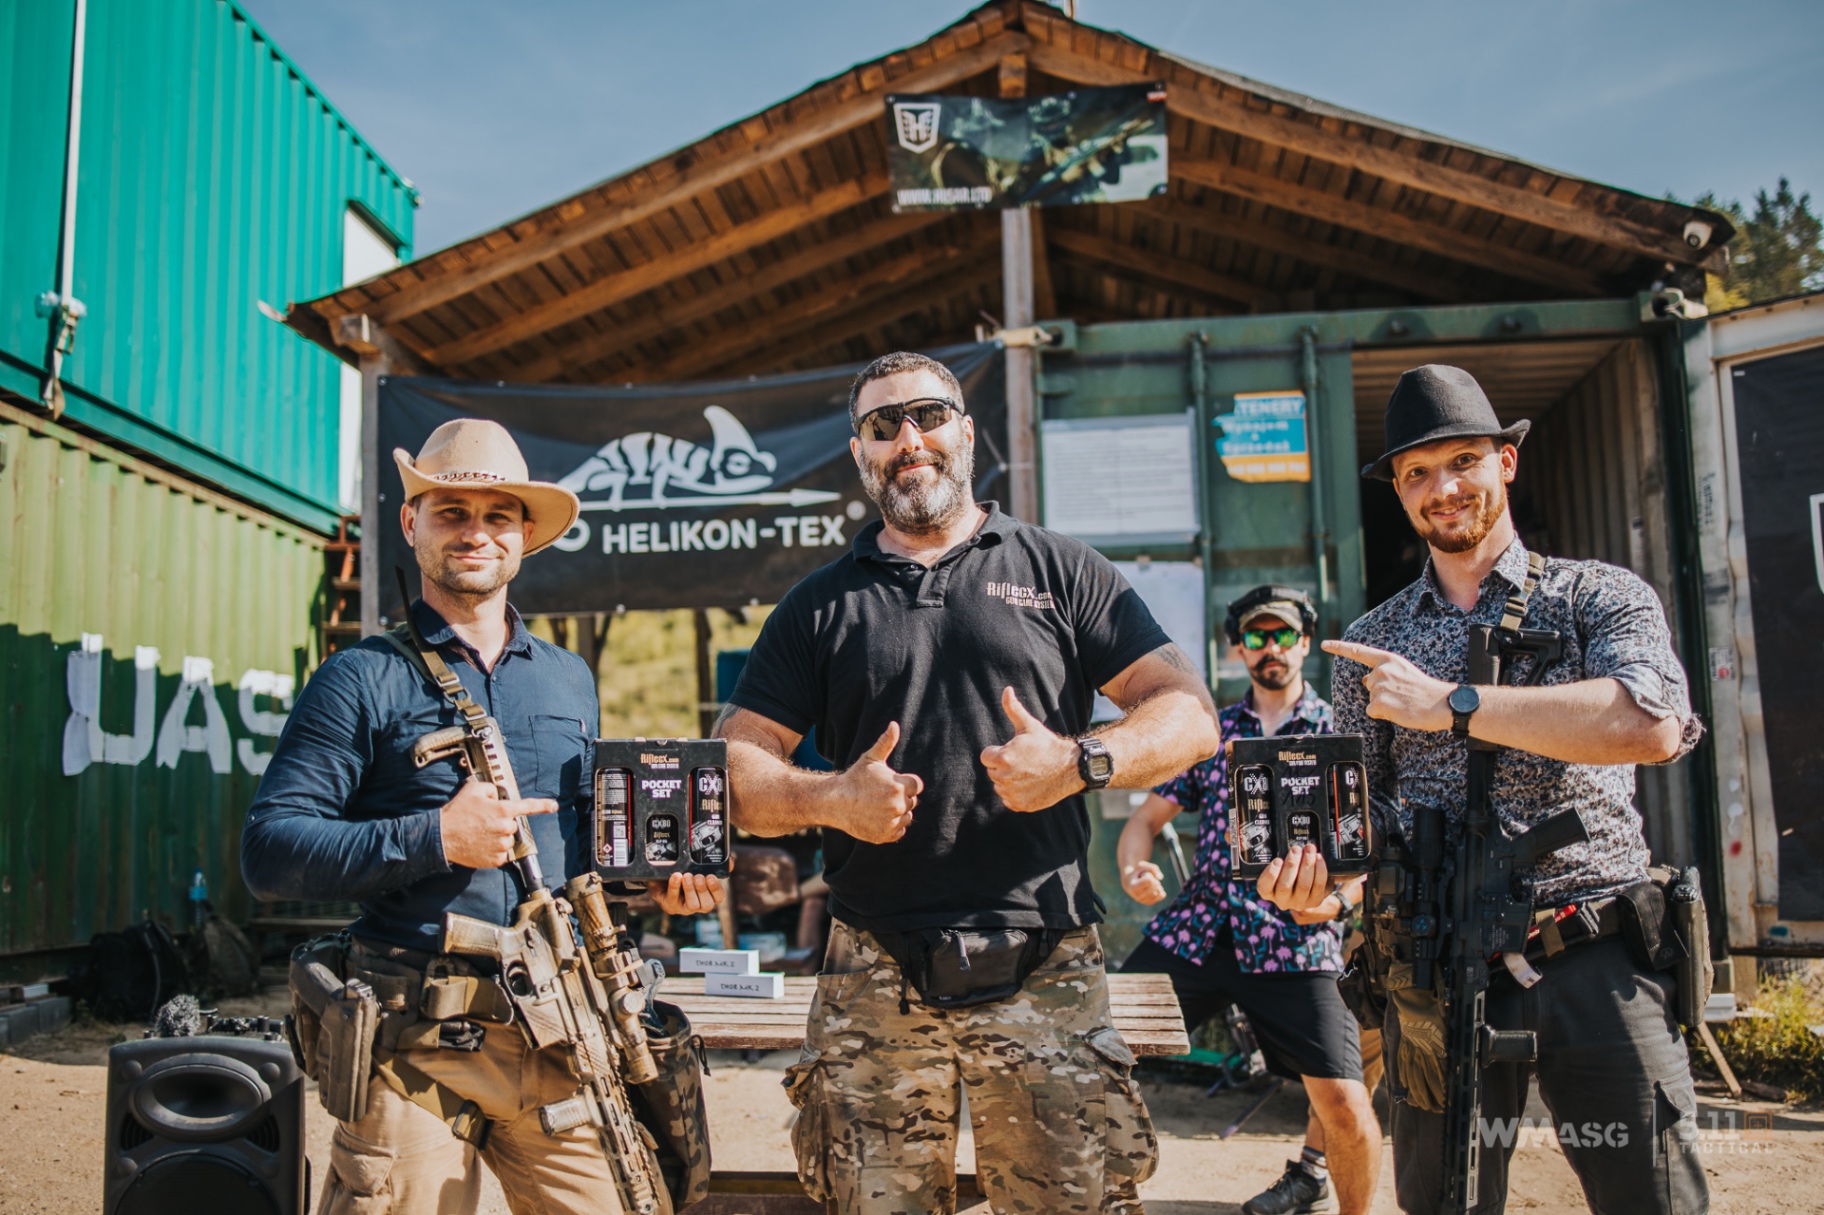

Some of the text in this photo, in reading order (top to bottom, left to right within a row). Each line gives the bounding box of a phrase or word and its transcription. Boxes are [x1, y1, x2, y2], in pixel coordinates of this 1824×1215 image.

[641, 780, 682, 790] POCKET
[1281, 776, 1320, 787] POCKET
[652, 789, 672, 798] SET
[1291, 785, 1310, 795] SET
